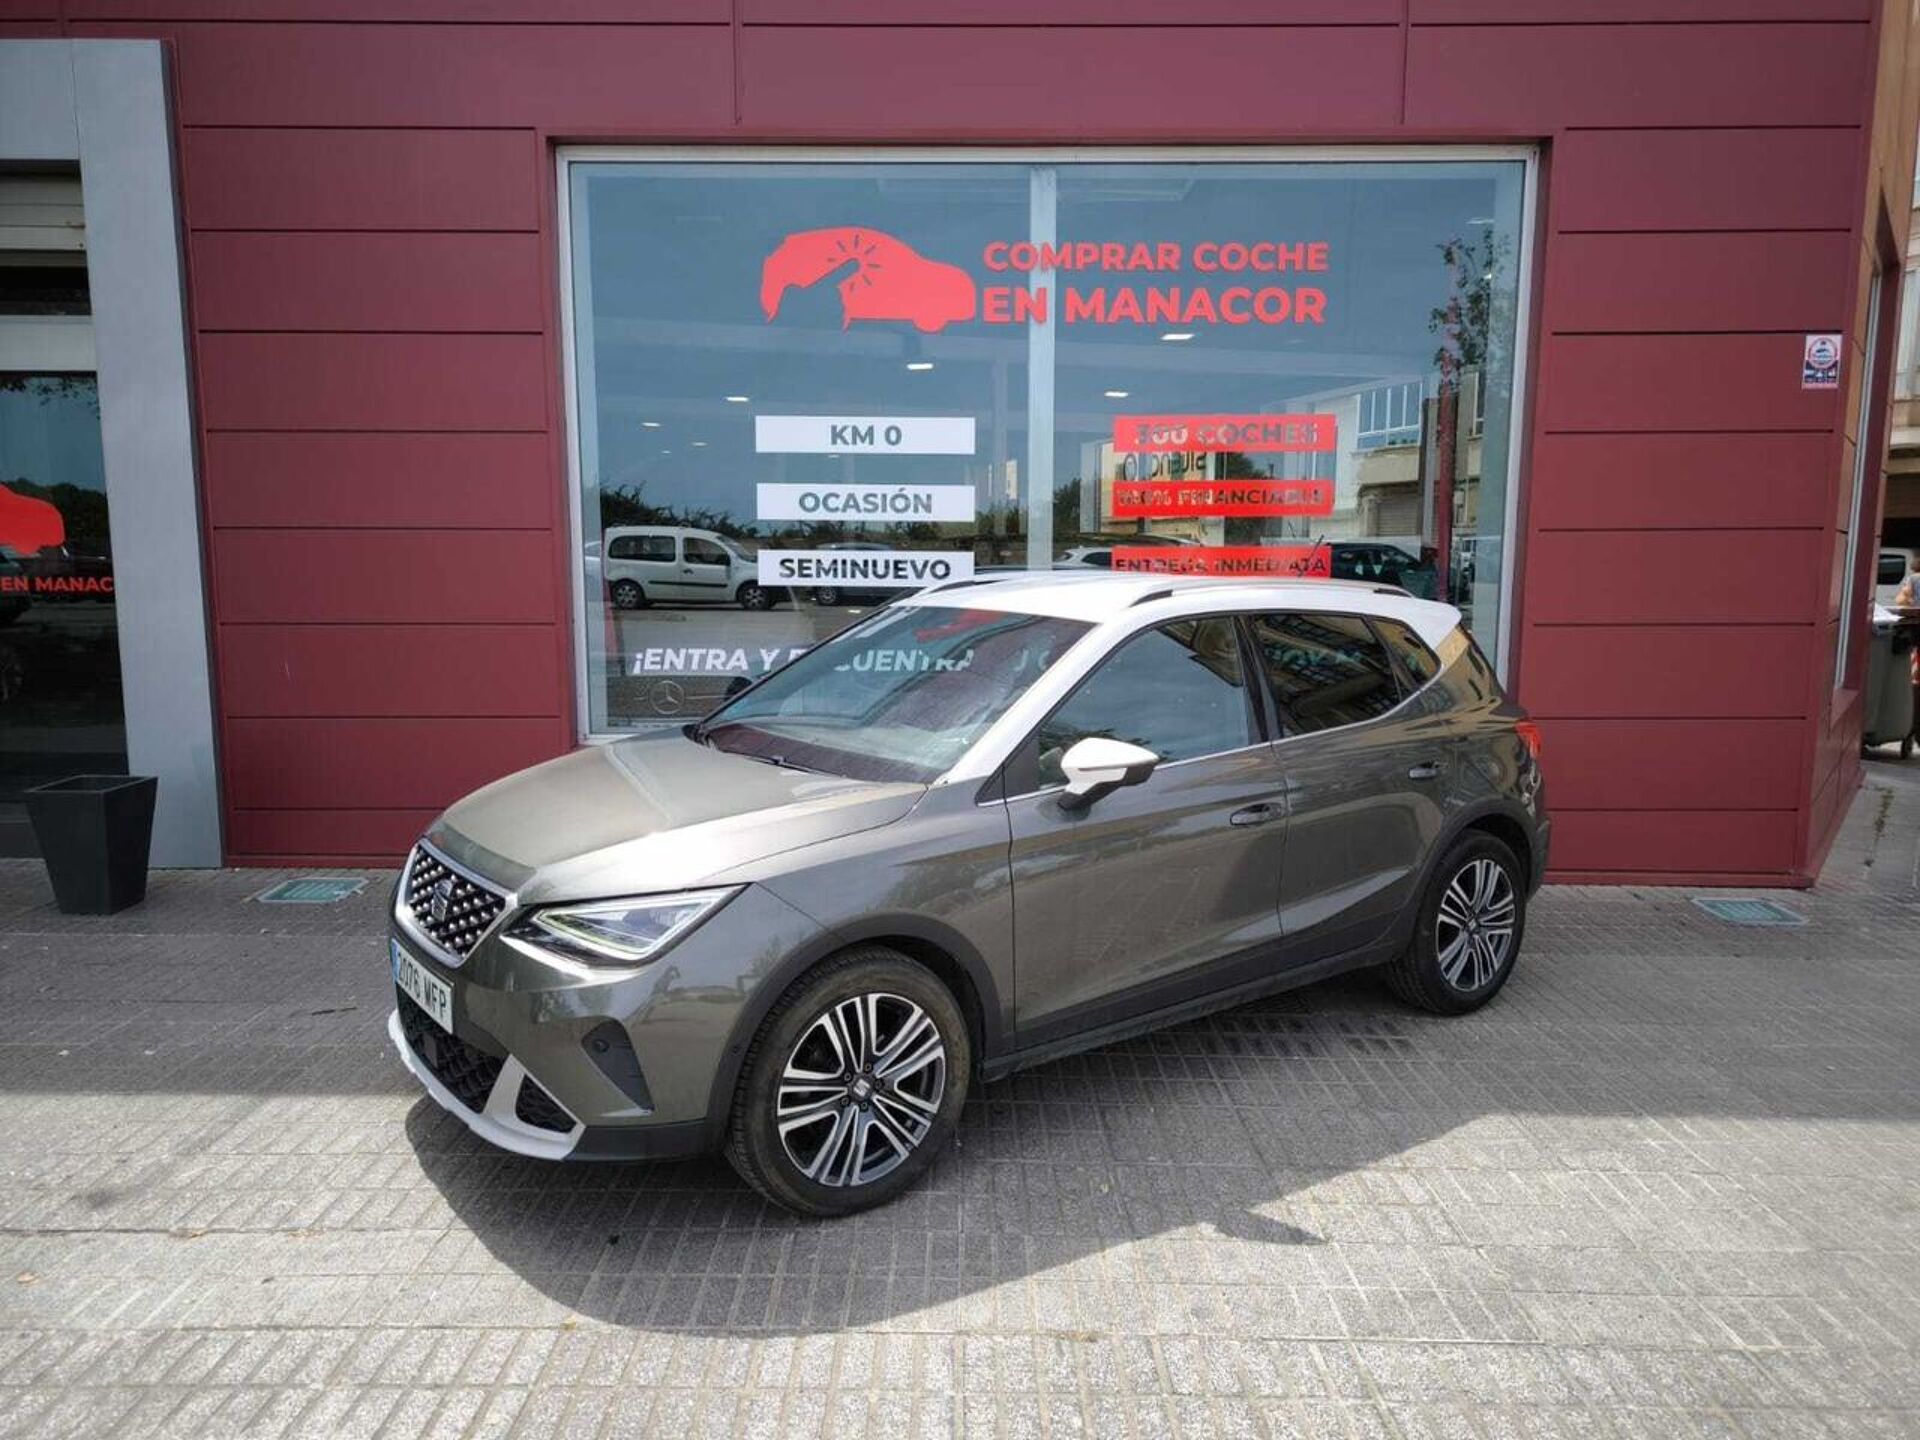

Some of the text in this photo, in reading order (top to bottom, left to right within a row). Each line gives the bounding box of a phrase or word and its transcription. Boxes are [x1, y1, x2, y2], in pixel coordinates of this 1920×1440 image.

[983, 241, 1331, 272] COMPRAR COCHE
[982, 286, 1328, 325] EN MANACOR
[830, 424, 903, 446] KM 0
[798, 487, 933, 514] OCASIÓN
[778, 557, 952, 581] SEMINUEVO
[1214, 557, 1327, 574] INMEDATA
[1, 576, 29, 592] EN
[632, 648, 749, 674] ¡ENTRA
[759, 648, 781, 671] Y
